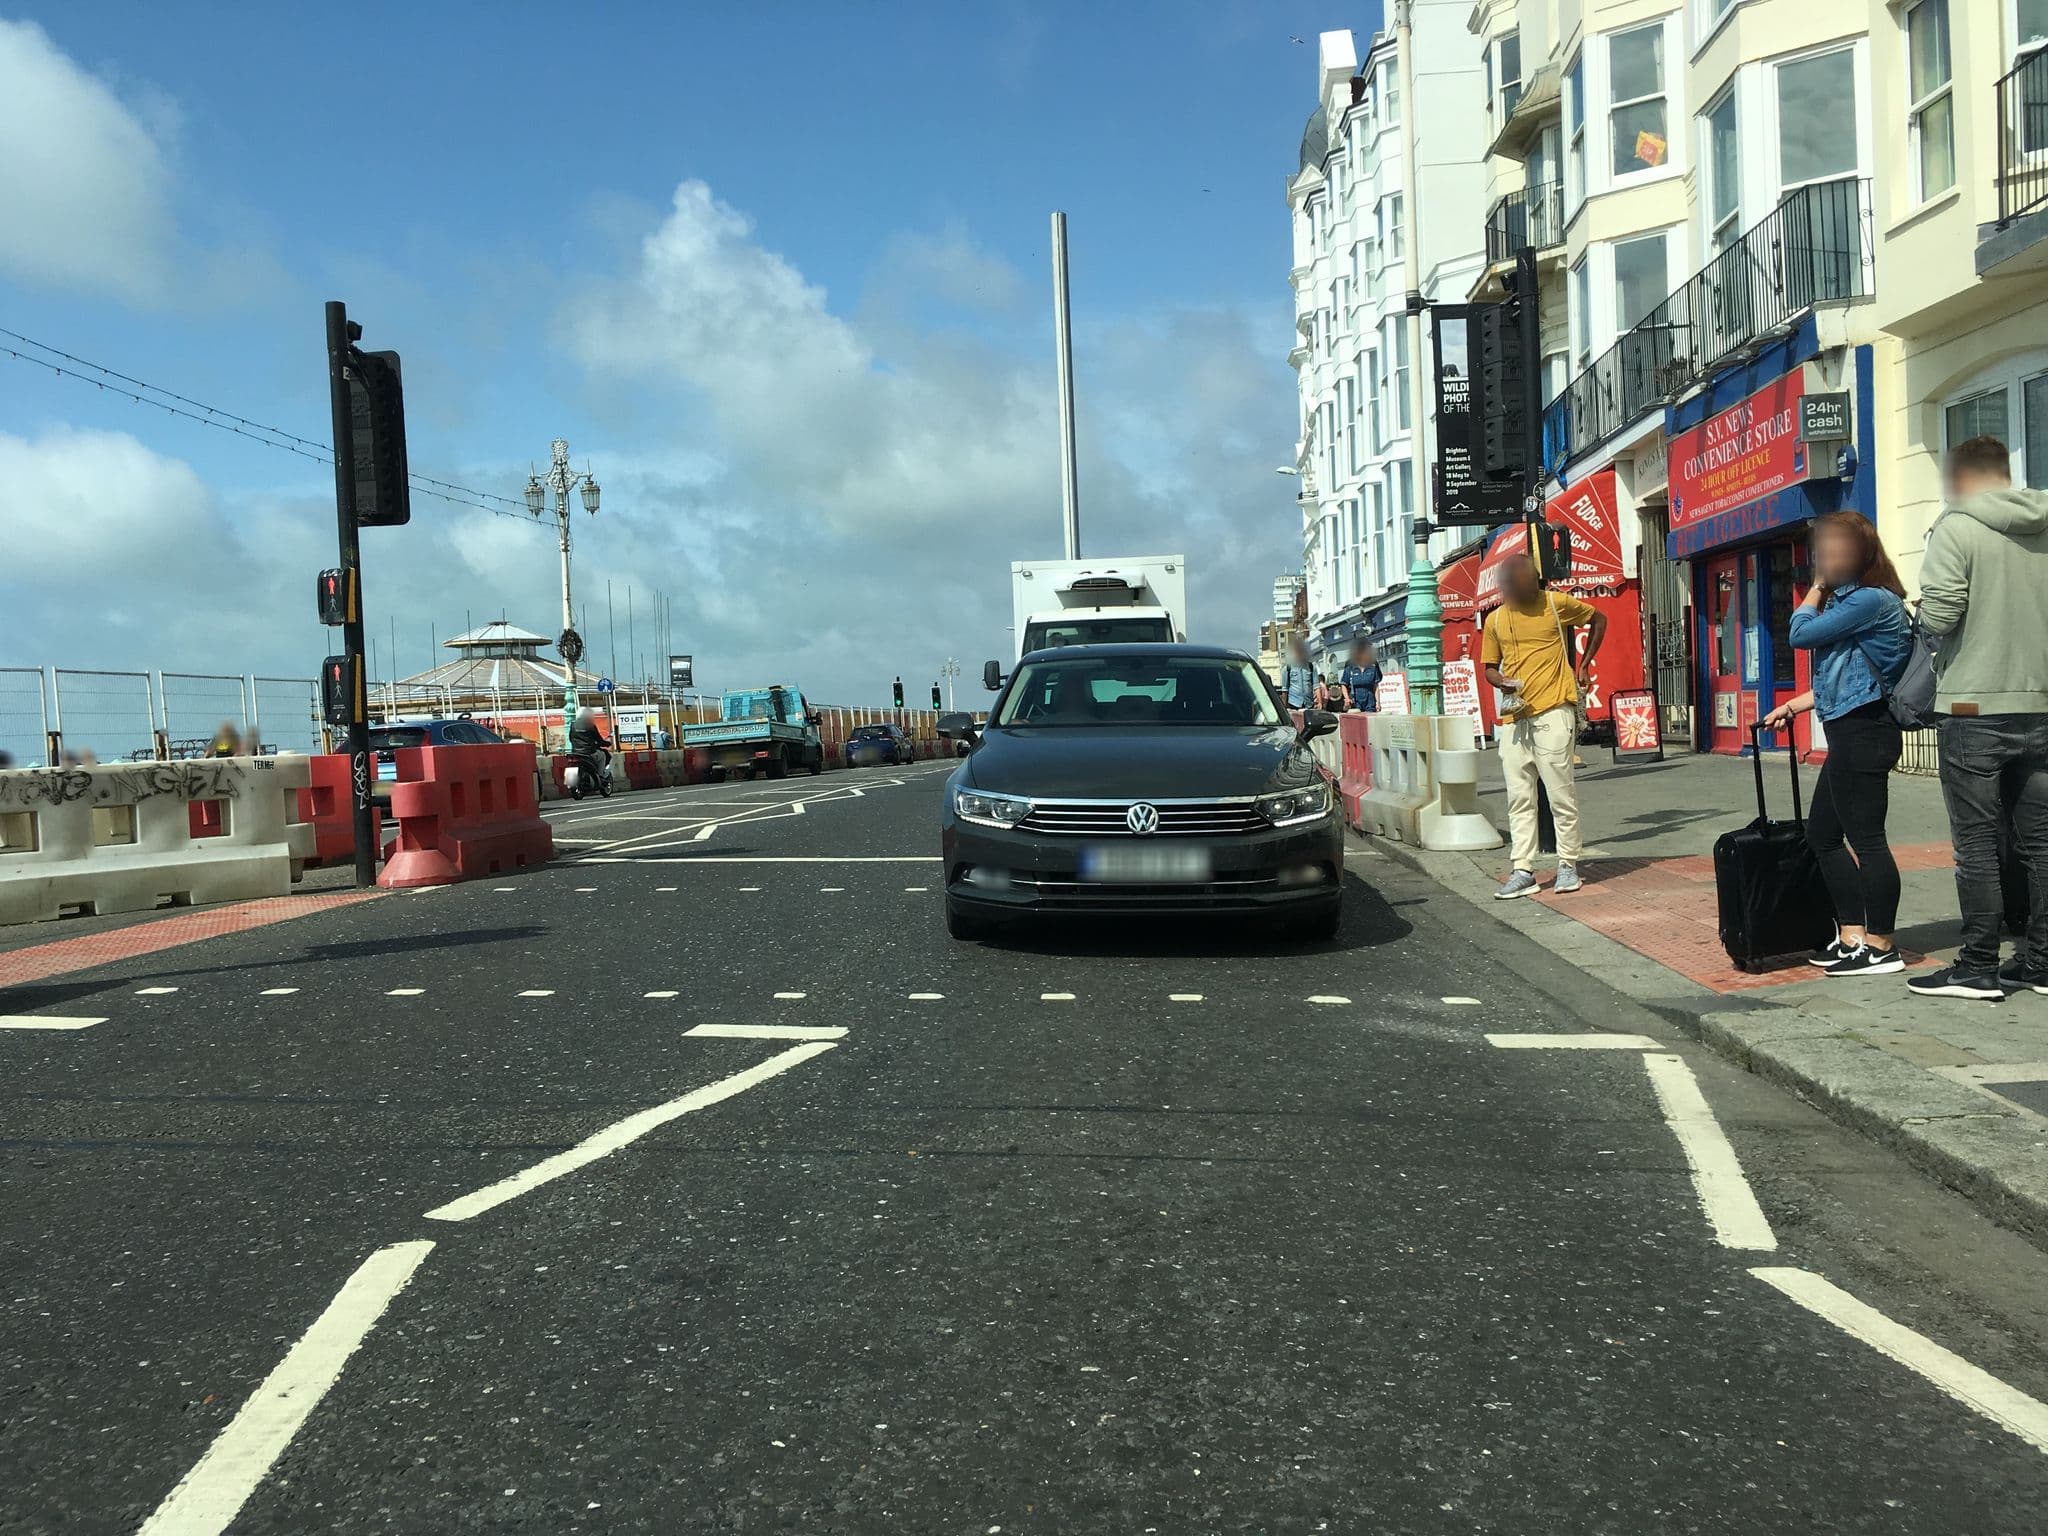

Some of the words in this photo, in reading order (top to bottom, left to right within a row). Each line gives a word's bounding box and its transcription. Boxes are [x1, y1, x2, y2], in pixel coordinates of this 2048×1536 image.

[1443, 404, 1454, 414] OF
[1807, 402, 1841, 415] 24hr
[1725, 402, 1754, 435] NEWS
[1808, 414, 1842, 428] cash
[1684, 430, 1754, 480] CONVENIENCE
[1755, 408, 1793, 448] STORE
[1446, 447, 1467, 455] Brighton
[1741, 448, 1771, 475] LICENCE
[1451, 480, 1477, 488] September
[1570, 494, 1604, 531] FUDGE
[1577, 562, 1598, 572] ROCK
[1579, 575, 1615, 585] DRINKS
[1615, 695, 1652, 705] BITCOIN
